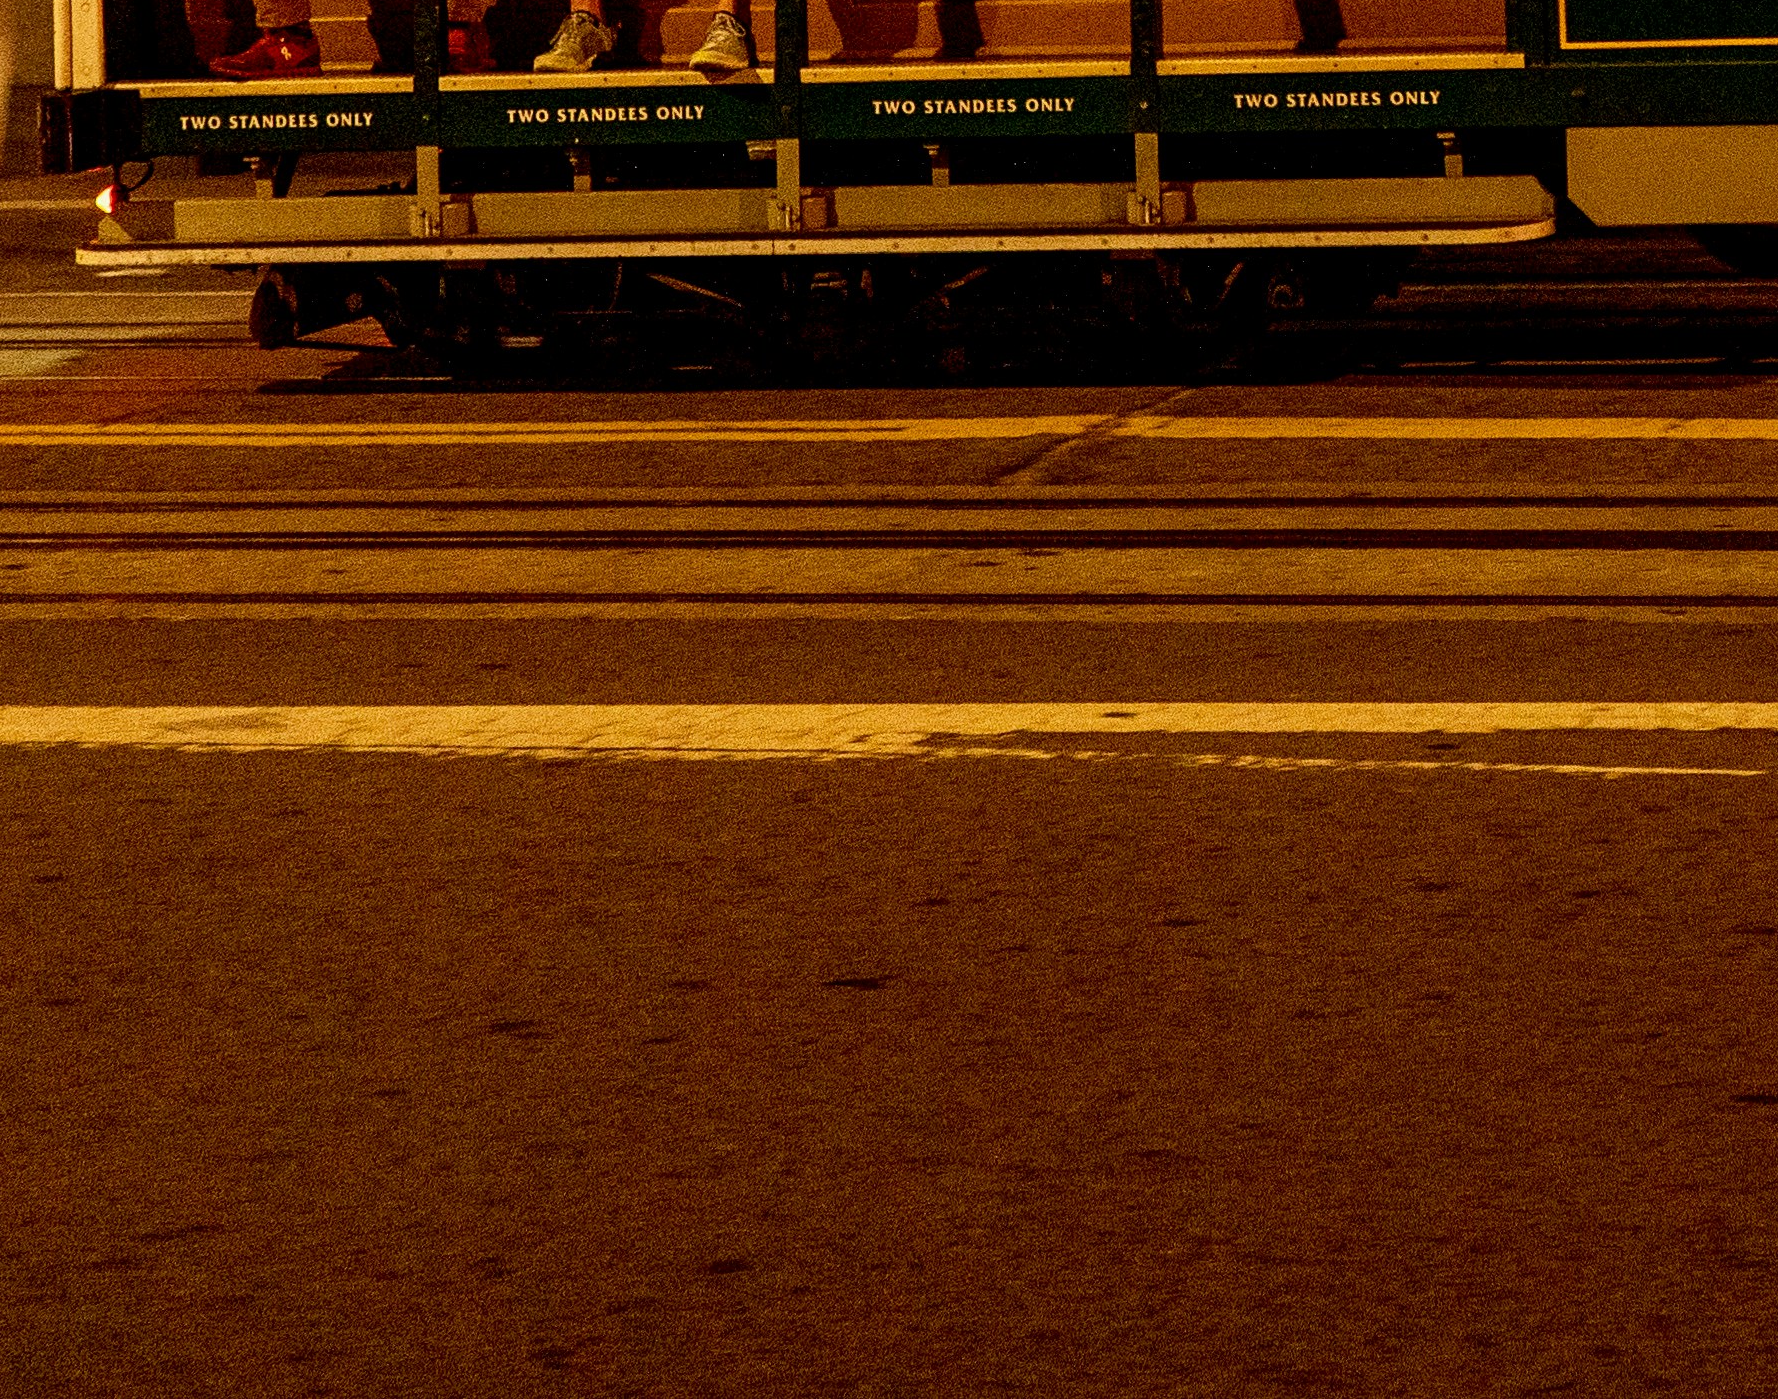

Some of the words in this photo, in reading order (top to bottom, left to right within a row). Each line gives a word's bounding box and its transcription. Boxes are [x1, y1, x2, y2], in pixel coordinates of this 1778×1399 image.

[874, 101, 917, 116] TWO
[925, 99, 1018, 115] STANDEES
[1026, 98, 1076, 113] ONLY
[1235, 94, 1279, 109] TWO
[1287, 92, 1382, 108] STANDEES
[1390, 91, 1441, 106] ONLY
[181, 117, 222, 131] TWO
[230, 114, 319, 130] STANDEES
[327, 113, 374, 129] ONLY
[508, 109, 550, 124] TWO
[558, 107, 649, 123] STANDEES
[657, 106, 705, 121] ONLY
